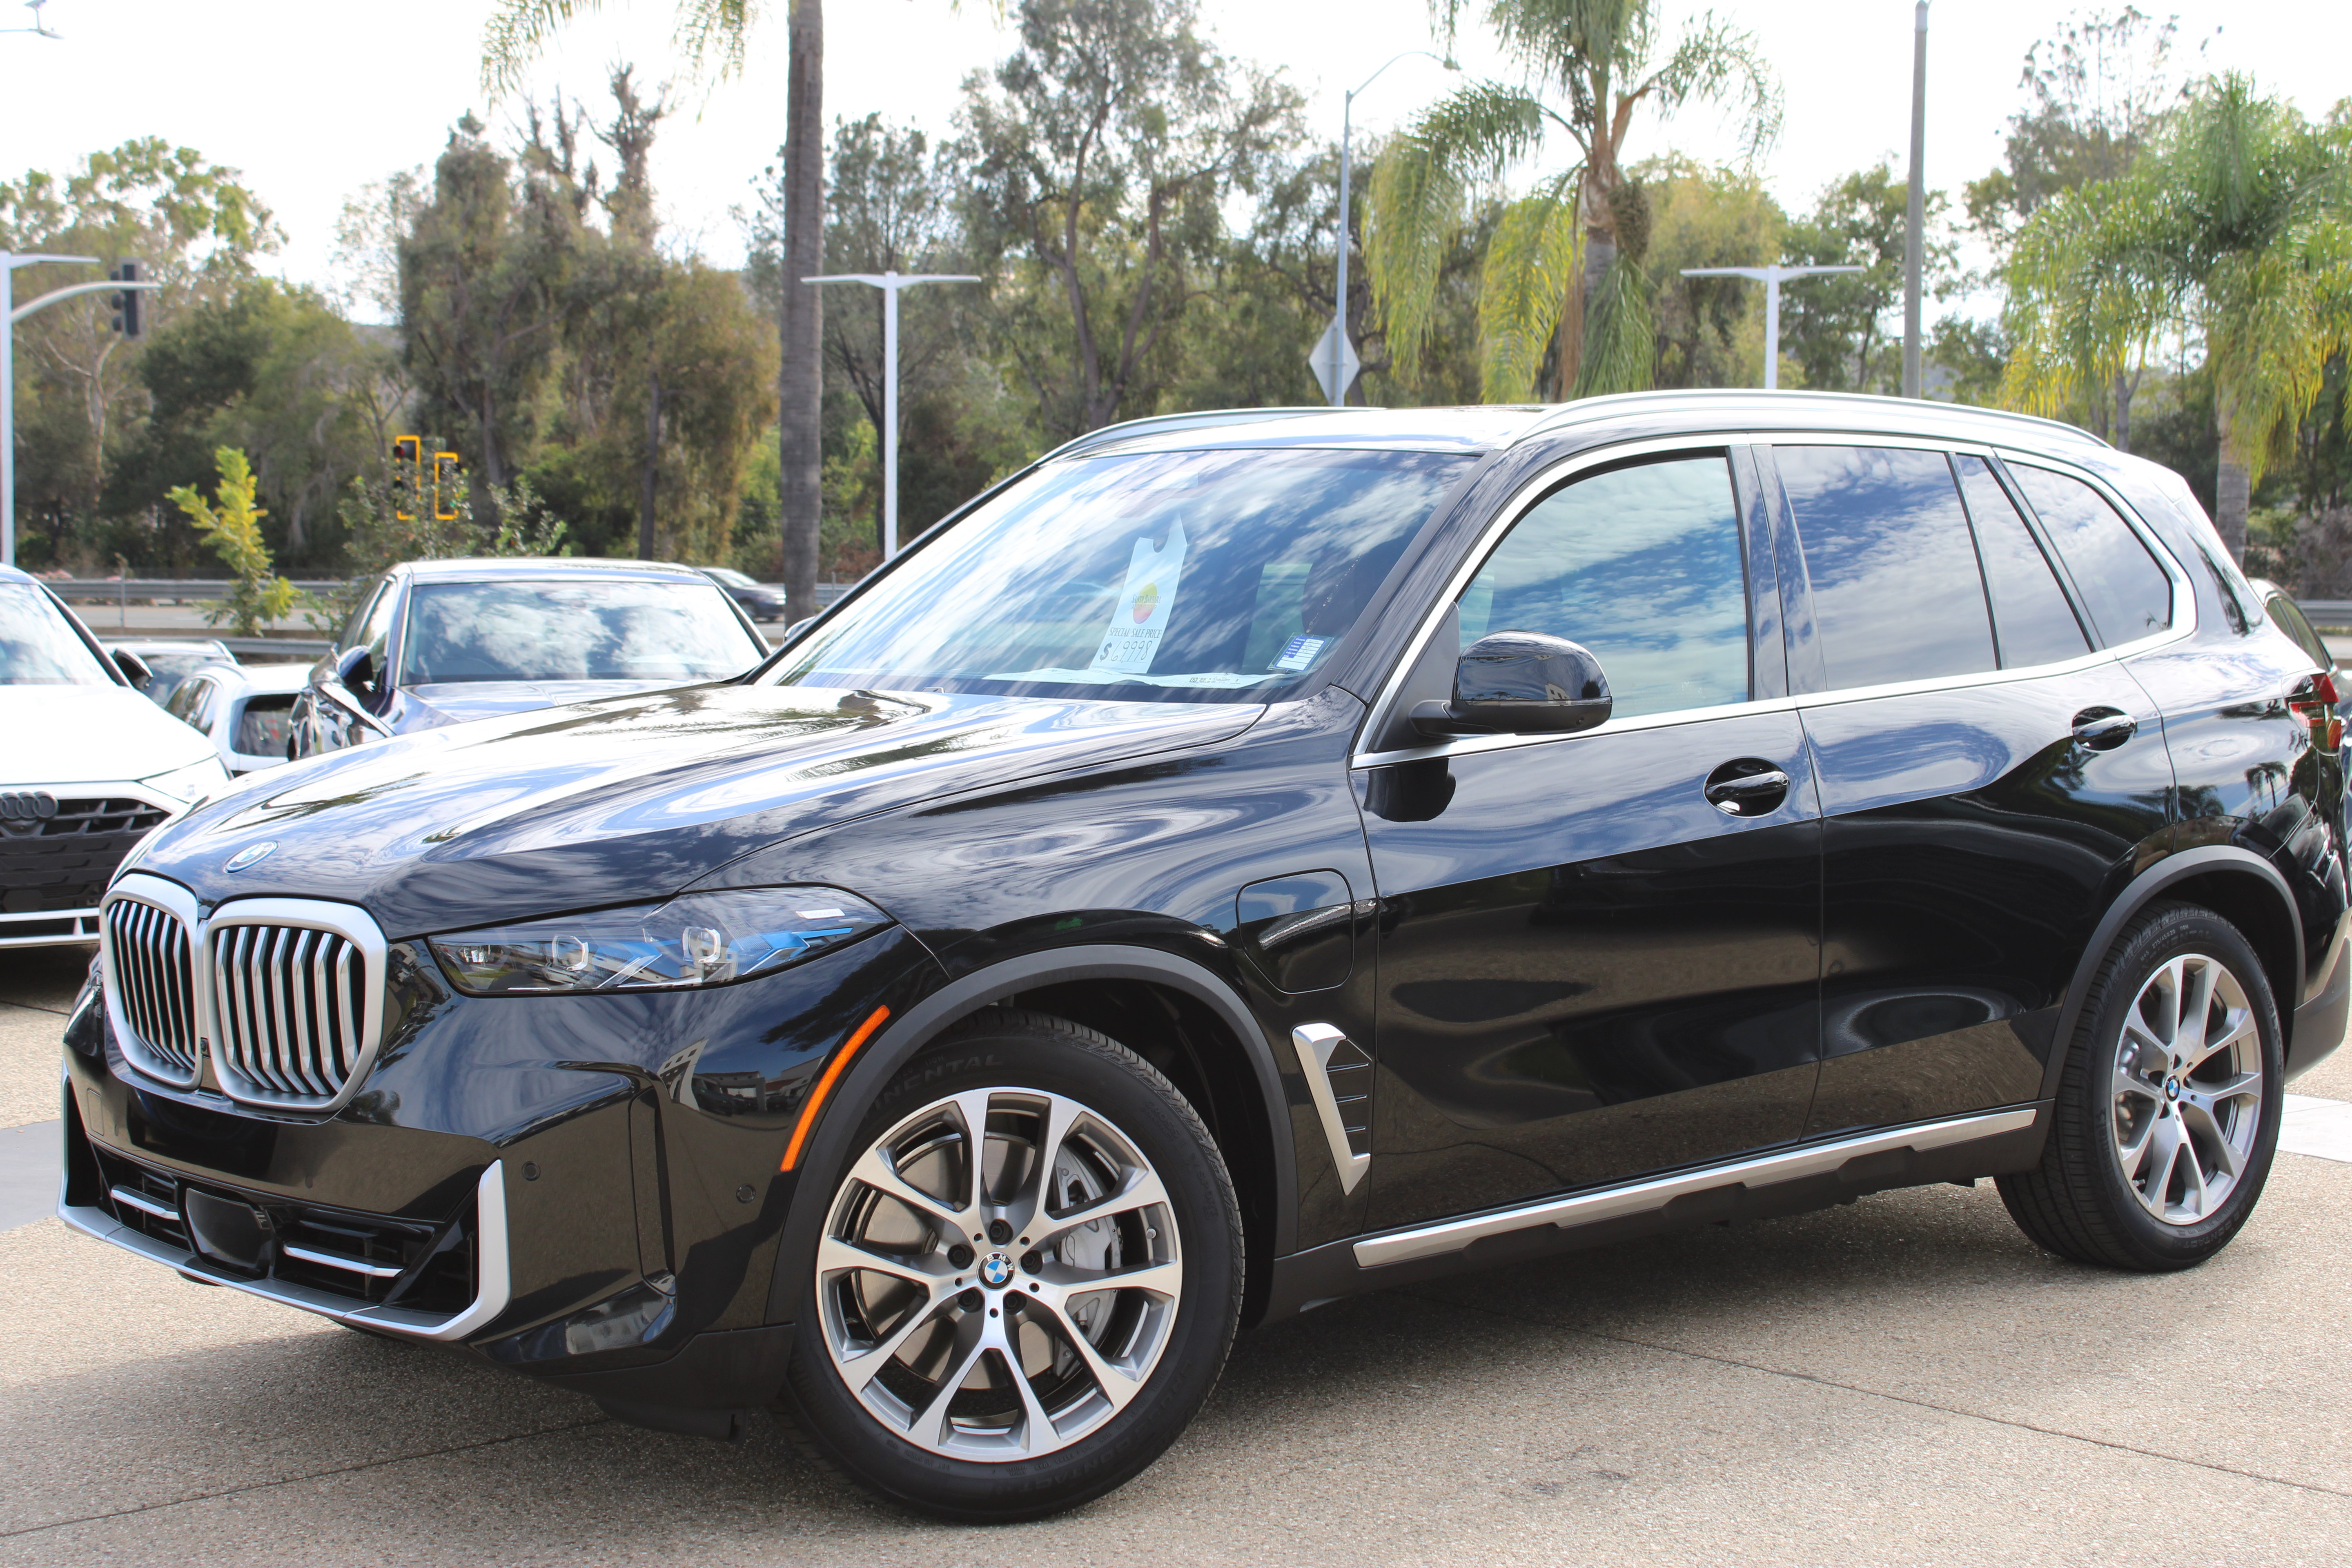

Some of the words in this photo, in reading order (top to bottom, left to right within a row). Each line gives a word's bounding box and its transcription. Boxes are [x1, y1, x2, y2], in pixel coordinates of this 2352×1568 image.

[1108, 627, 1130, 637] SPECIAL
[1131, 628, 1145, 637] SALE
[1145, 629, 1162, 638] PRICE
[987, 1254, 1013, 1270] BMW
